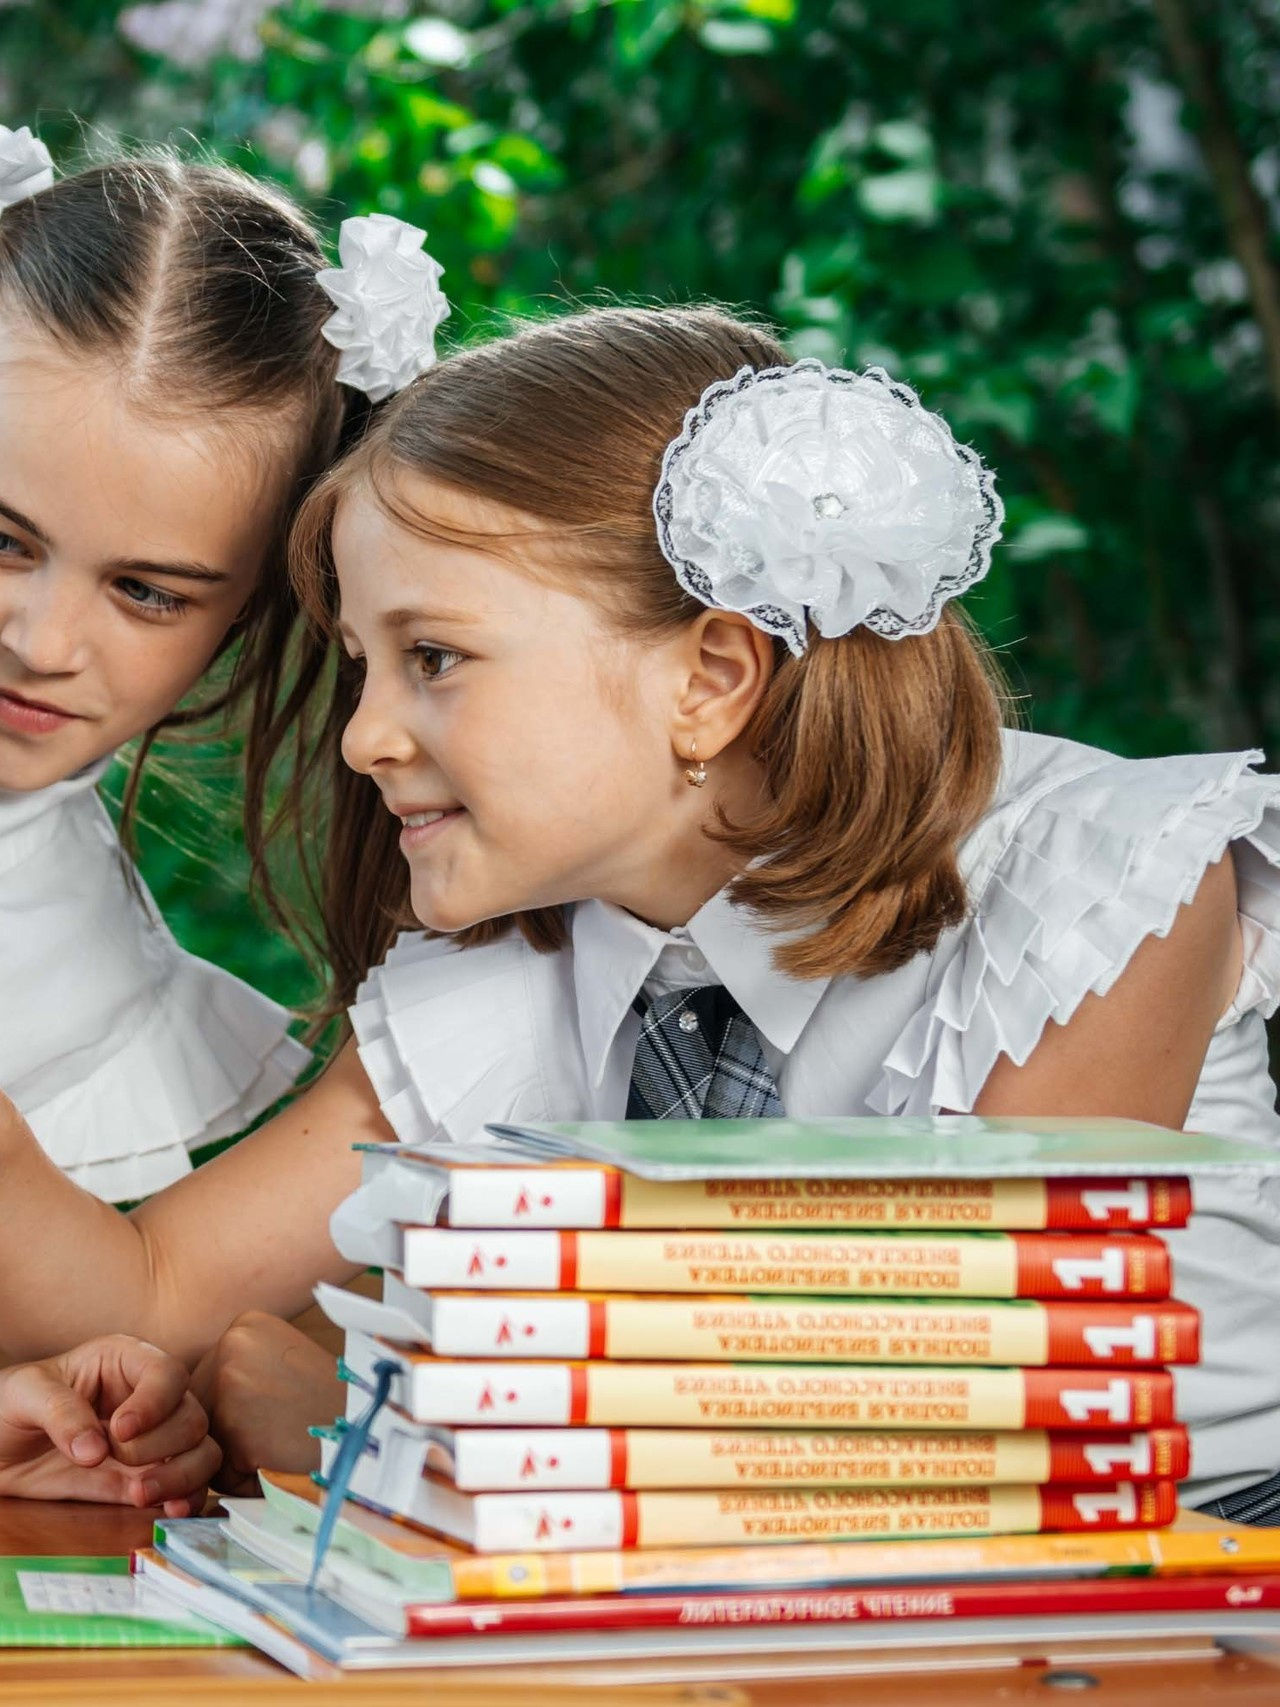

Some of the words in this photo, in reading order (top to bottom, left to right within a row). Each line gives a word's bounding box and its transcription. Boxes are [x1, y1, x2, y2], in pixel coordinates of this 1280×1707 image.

[705, 1178, 801, 1197] ЧТЕНИЯ
[806, 1179, 994, 1198] ВНЕКЛАССНОГО
[1081, 1180, 1148, 1221] 1
[730, 1201, 886, 1221] БИБЛИОТЕКА
[895, 1202, 992, 1221] ПОЛНАЯ
[664, 1244, 759, 1264] ЧТЕНИЯ
[768, 1246, 962, 1266] ВНЕКЛАССНОГО
[689, 1267, 850, 1288] БИБЛИОТЕКА
[859, 1269, 961, 1289] ПОЛНАЯ
[1052, 1247, 1124, 1291] 1
[693, 1311, 791, 1331] ЧТЕНИЯ
[797, 1313, 993, 1333] ВНЕКЛАССНОГО
[718, 1335, 880, 1356] БИБЛИОТЕКА
[1082, 1315, 1155, 1358] 1
[888, 1337, 992, 1358] ПОЛНАЯ
[674, 1376, 771, 1396] ЧТЕНИЯ
[777, 1378, 971, 1398] ВНЕКЛАССНОГО
[698, 1400, 860, 1420] БИБЛИОТЕКА
[1059, 1378, 1130, 1423] 1
[868, 1401, 970, 1421] ПОЛНАЯ
[710, 1437, 806, 1457] ЧТЕНИЯ
[813, 1435, 998, 1455] ВНЕКЛАССНОГО
[1083, 1433, 1150, 1475] 1
[735, 1460, 891, 1479] БИБЛИОТЕКА
[898, 1459, 996, 1479] ПОЛНАЯ
[719, 1491, 809, 1514] ЧТЕНИЯ
[813, 1486, 992, 1509] ВНЕКЛАССНОГО
[1072, 1481, 1136, 1523] 1
[742, 1513, 890, 1536] БИБЛИОТЕКА
[898, 1510, 991, 1529] ПОЛНАЯ
[679, 1595, 860, 1624] ЛИТЕРАТУРНОЕ
[863, 1591, 955, 1618] ЧТЕНИЕ
